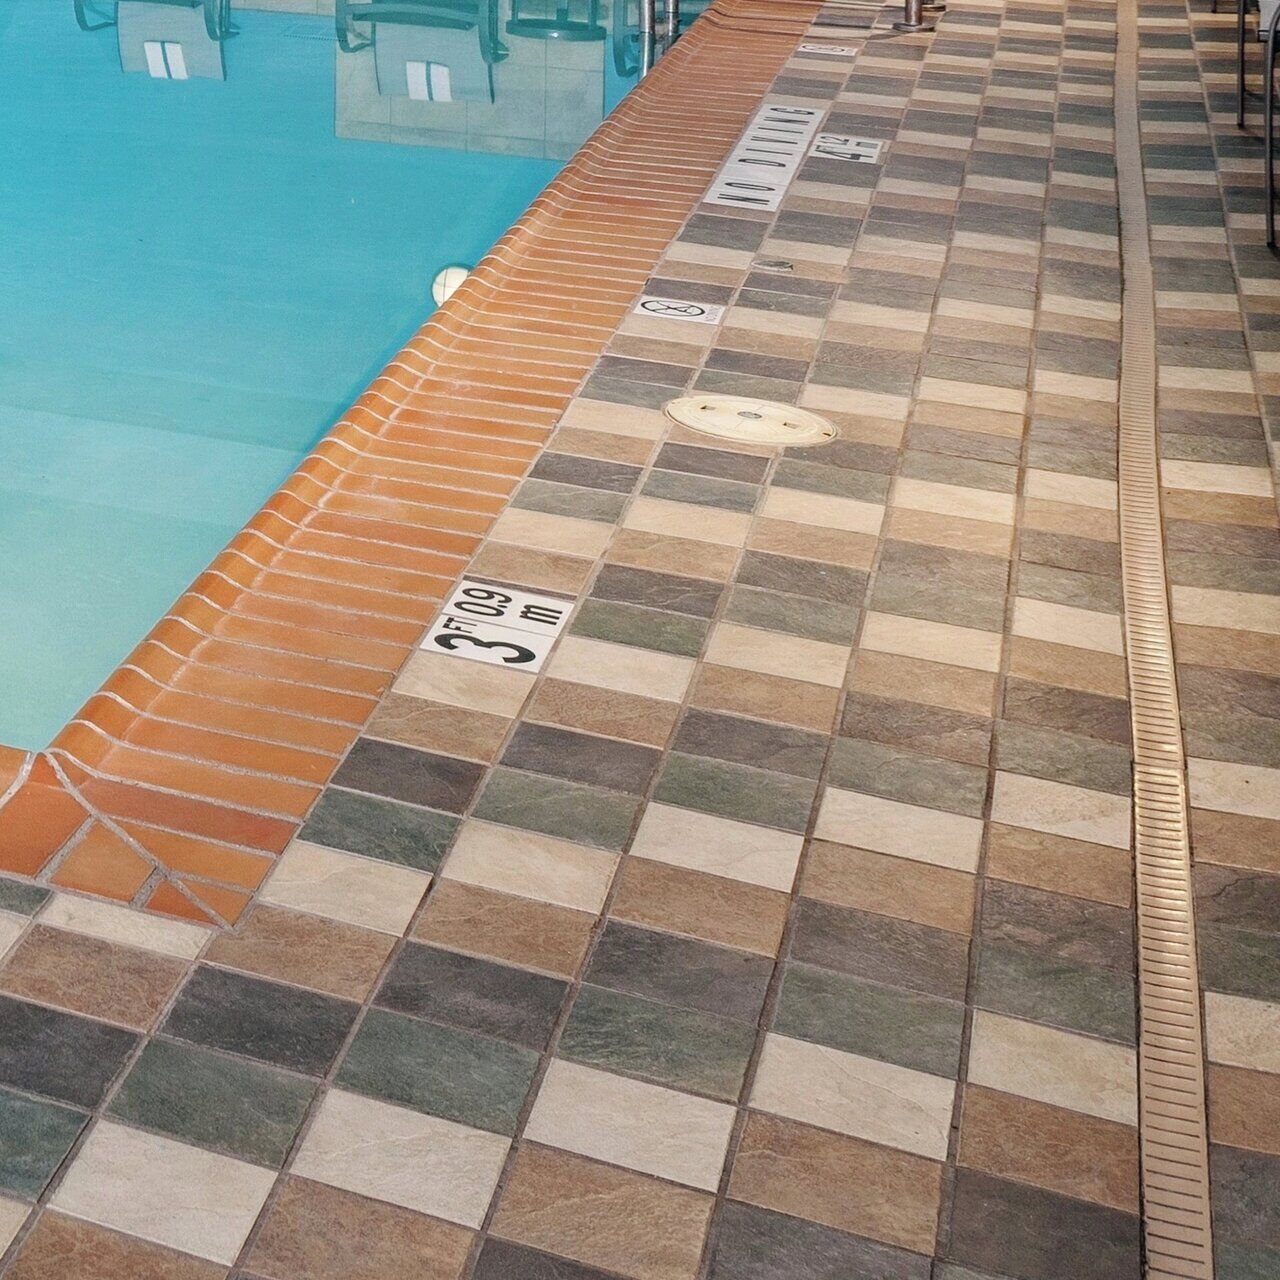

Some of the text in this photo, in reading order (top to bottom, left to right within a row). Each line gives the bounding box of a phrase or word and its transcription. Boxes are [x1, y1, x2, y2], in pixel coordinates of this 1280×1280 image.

[717, 107, 815, 206] NO DIVING
[814, 149, 874, 161] 4
[453, 587, 513, 618] 0.9
[519, 604, 563, 626] m
[434, 617, 536, 664] 3 FT
